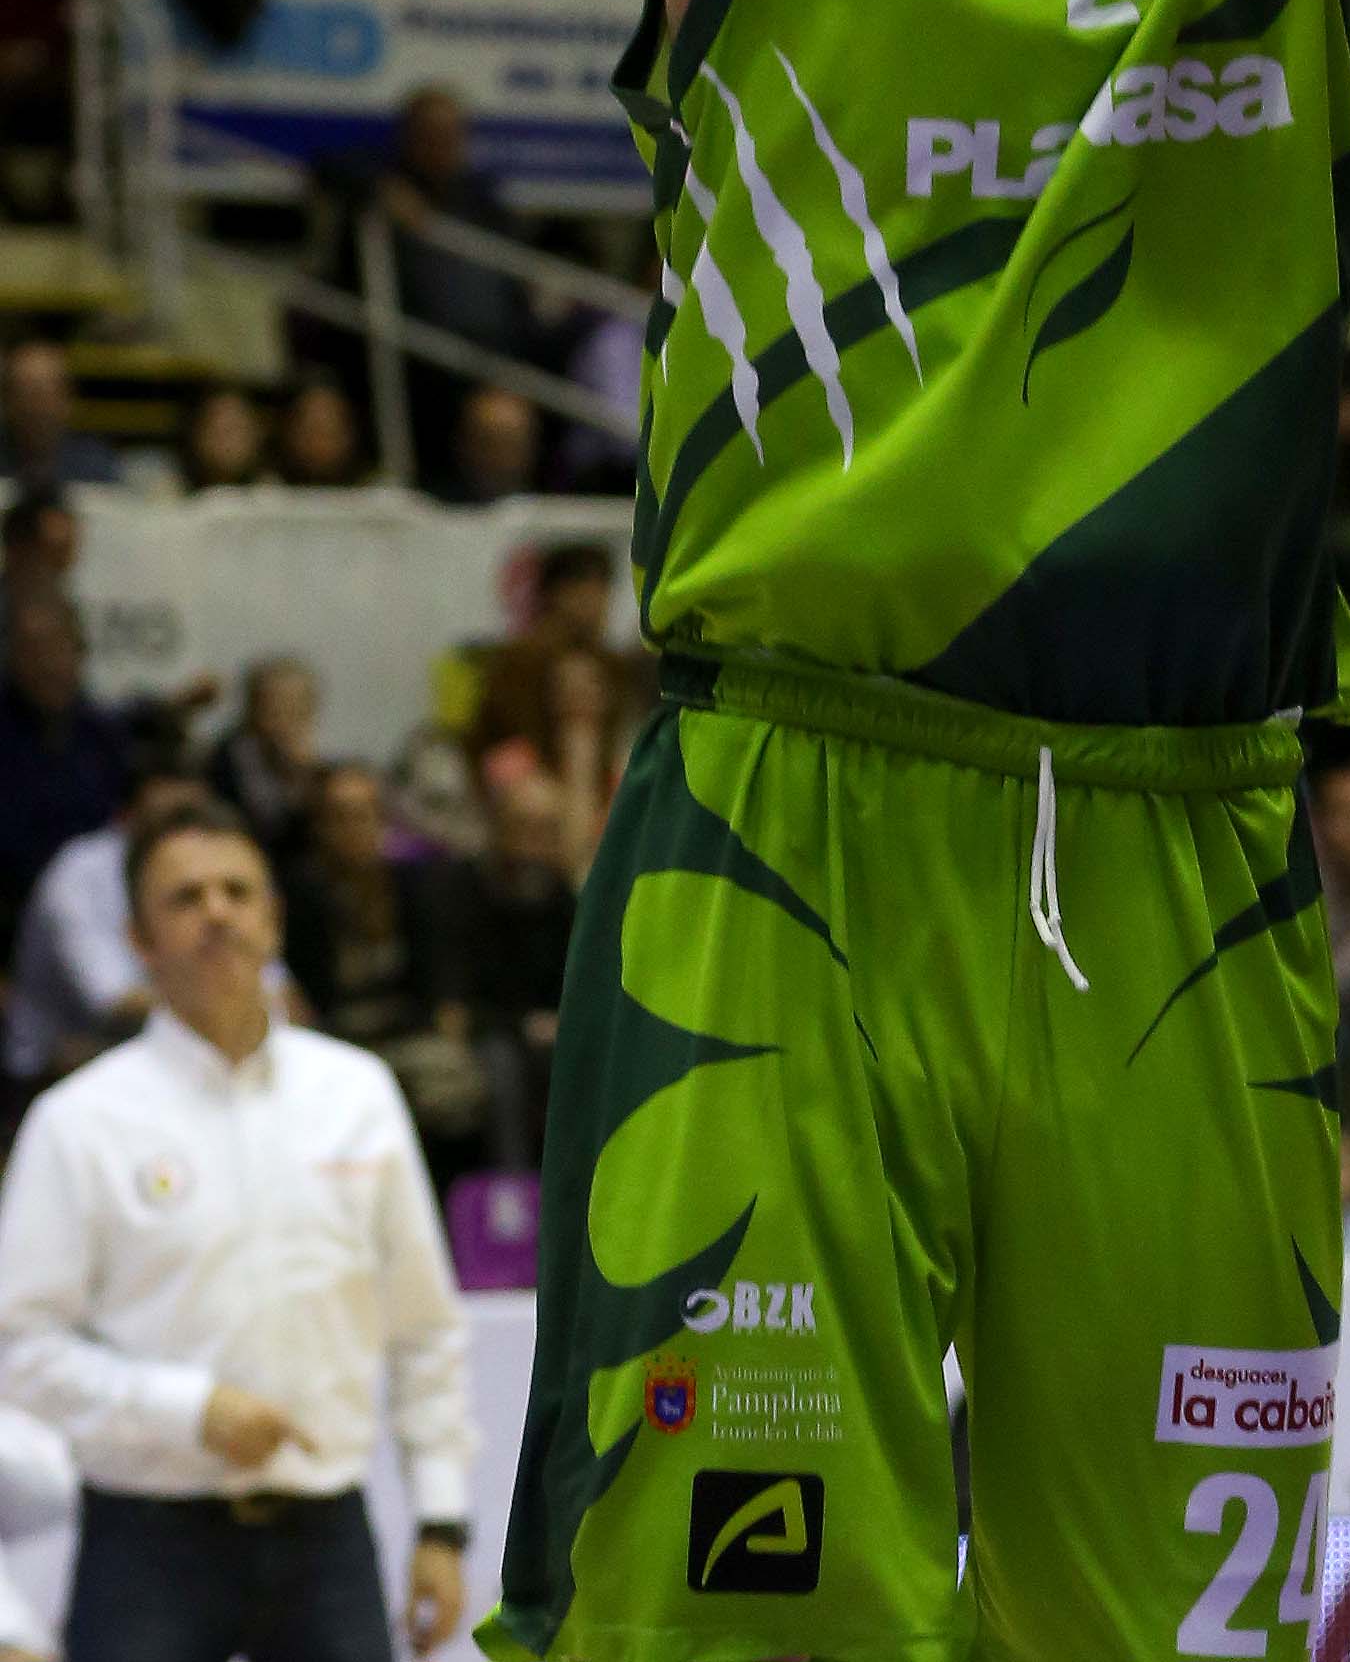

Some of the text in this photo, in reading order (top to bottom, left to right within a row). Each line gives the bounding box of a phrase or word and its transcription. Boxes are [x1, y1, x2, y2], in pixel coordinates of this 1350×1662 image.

[732, 1281, 817, 1333] BZK
[1190, 1358, 1288, 1389] desguaces
[711, 1382, 842, 1423] Pamplona
[1172, 1372, 1217, 1428] la
